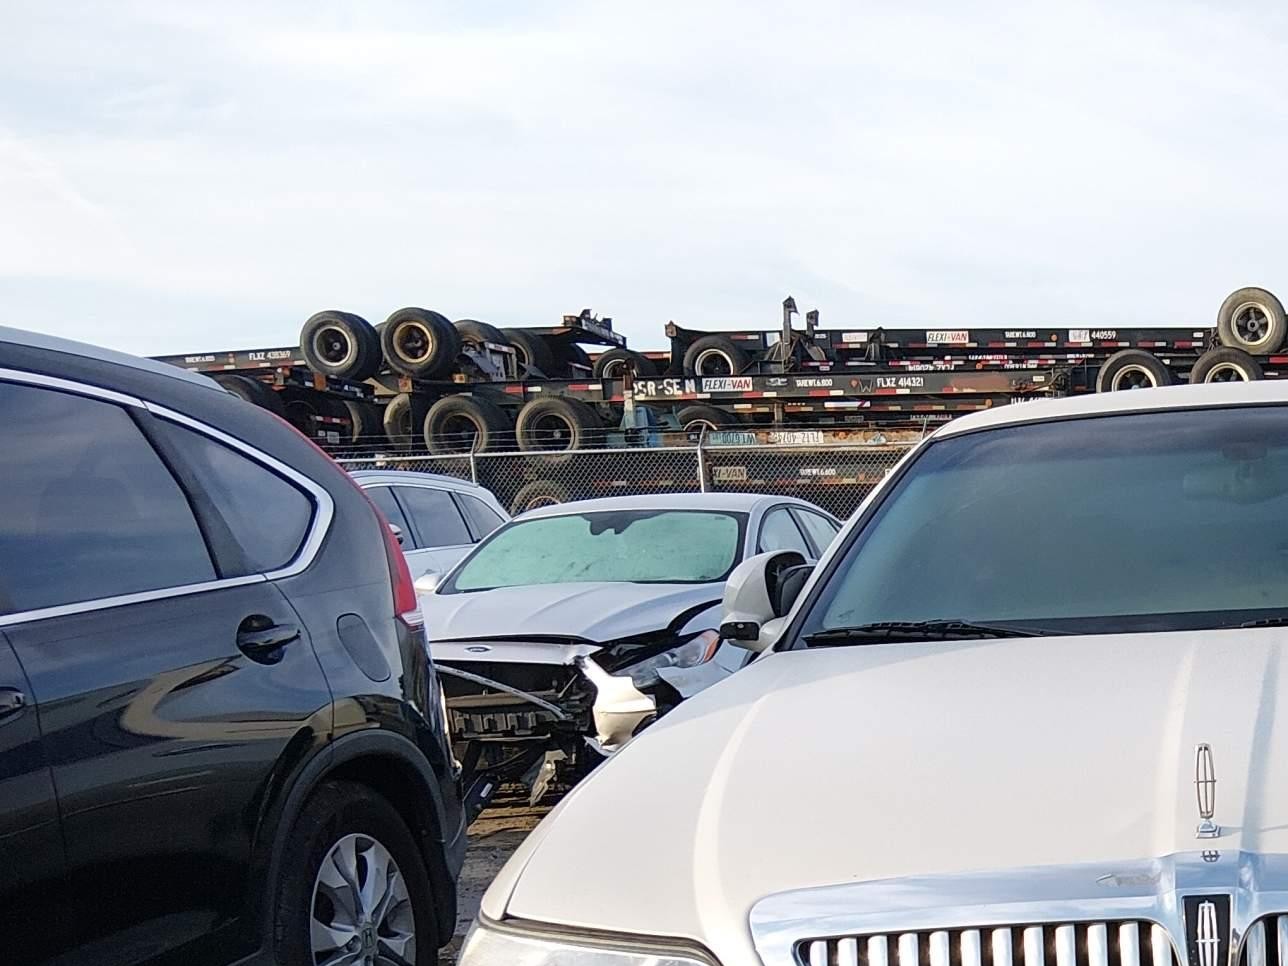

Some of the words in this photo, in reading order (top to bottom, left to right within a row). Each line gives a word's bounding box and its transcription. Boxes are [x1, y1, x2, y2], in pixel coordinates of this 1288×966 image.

[927, 332, 968, 342] FLEXI-VAN
[1091, 330, 1116, 340] 440559
[704, 380, 751, 391] FLEXI-VAN
[877, 377, 896, 387] FLXZ
[898, 377, 924, 387] 414321
